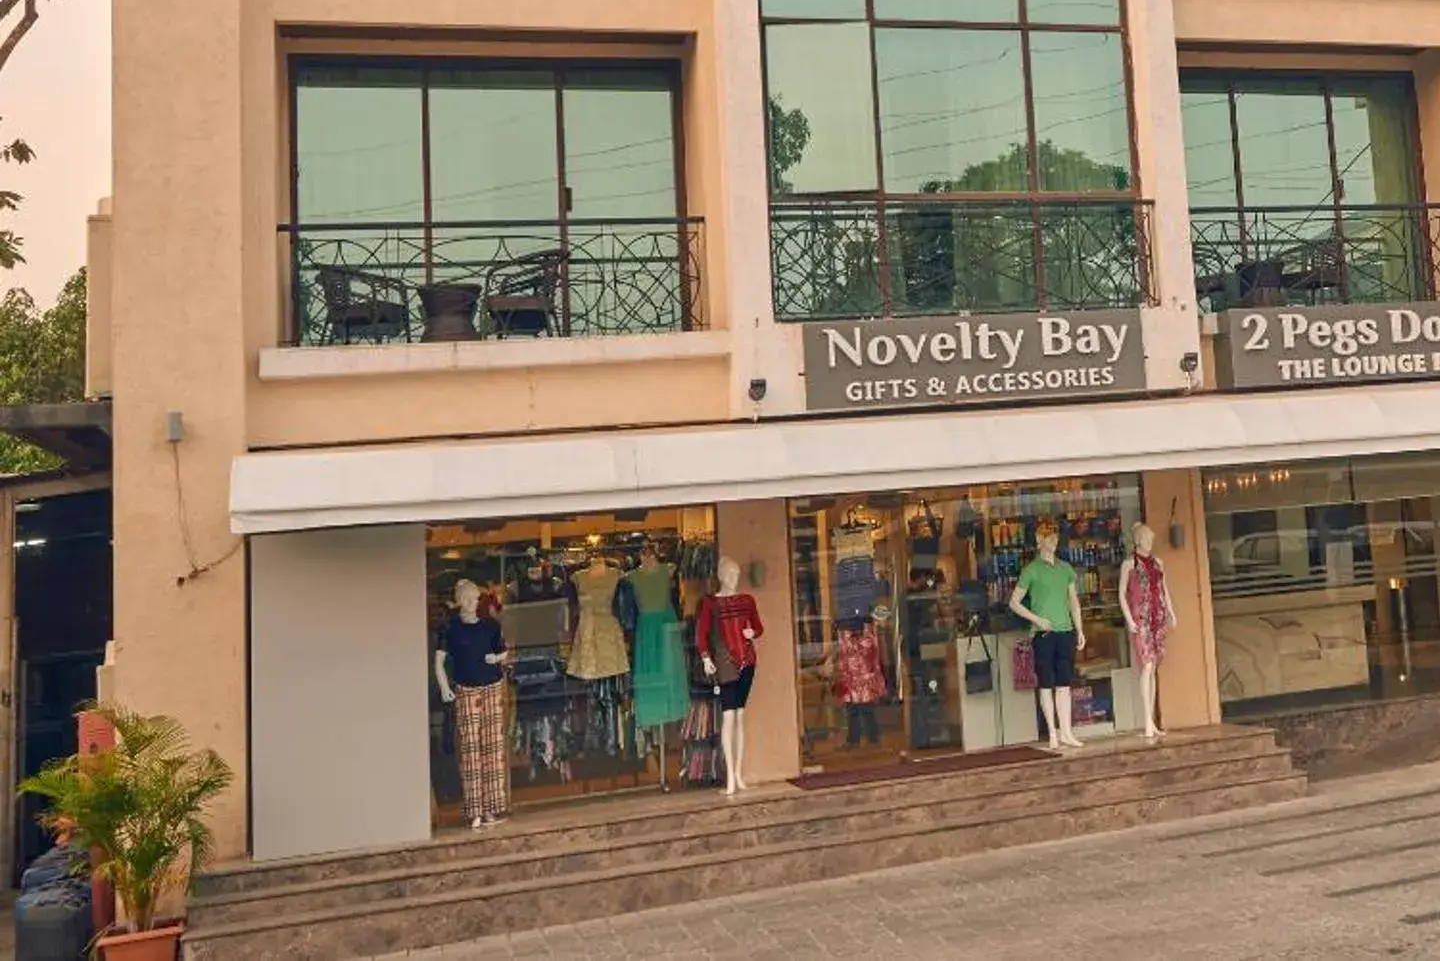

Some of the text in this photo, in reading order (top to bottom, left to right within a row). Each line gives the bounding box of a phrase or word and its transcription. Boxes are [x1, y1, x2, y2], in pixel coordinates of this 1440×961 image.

[822, 317, 1128, 369] Novelty Bay
[1241, 314, 1270, 350] 2
[1278, 313, 1379, 356] Pegs
[846, 366, 1115, 402] GIFTS & ACCESSORIES
[1278, 357, 1327, 380] THE
[1331, 353, 1427, 377] LOUNGE
